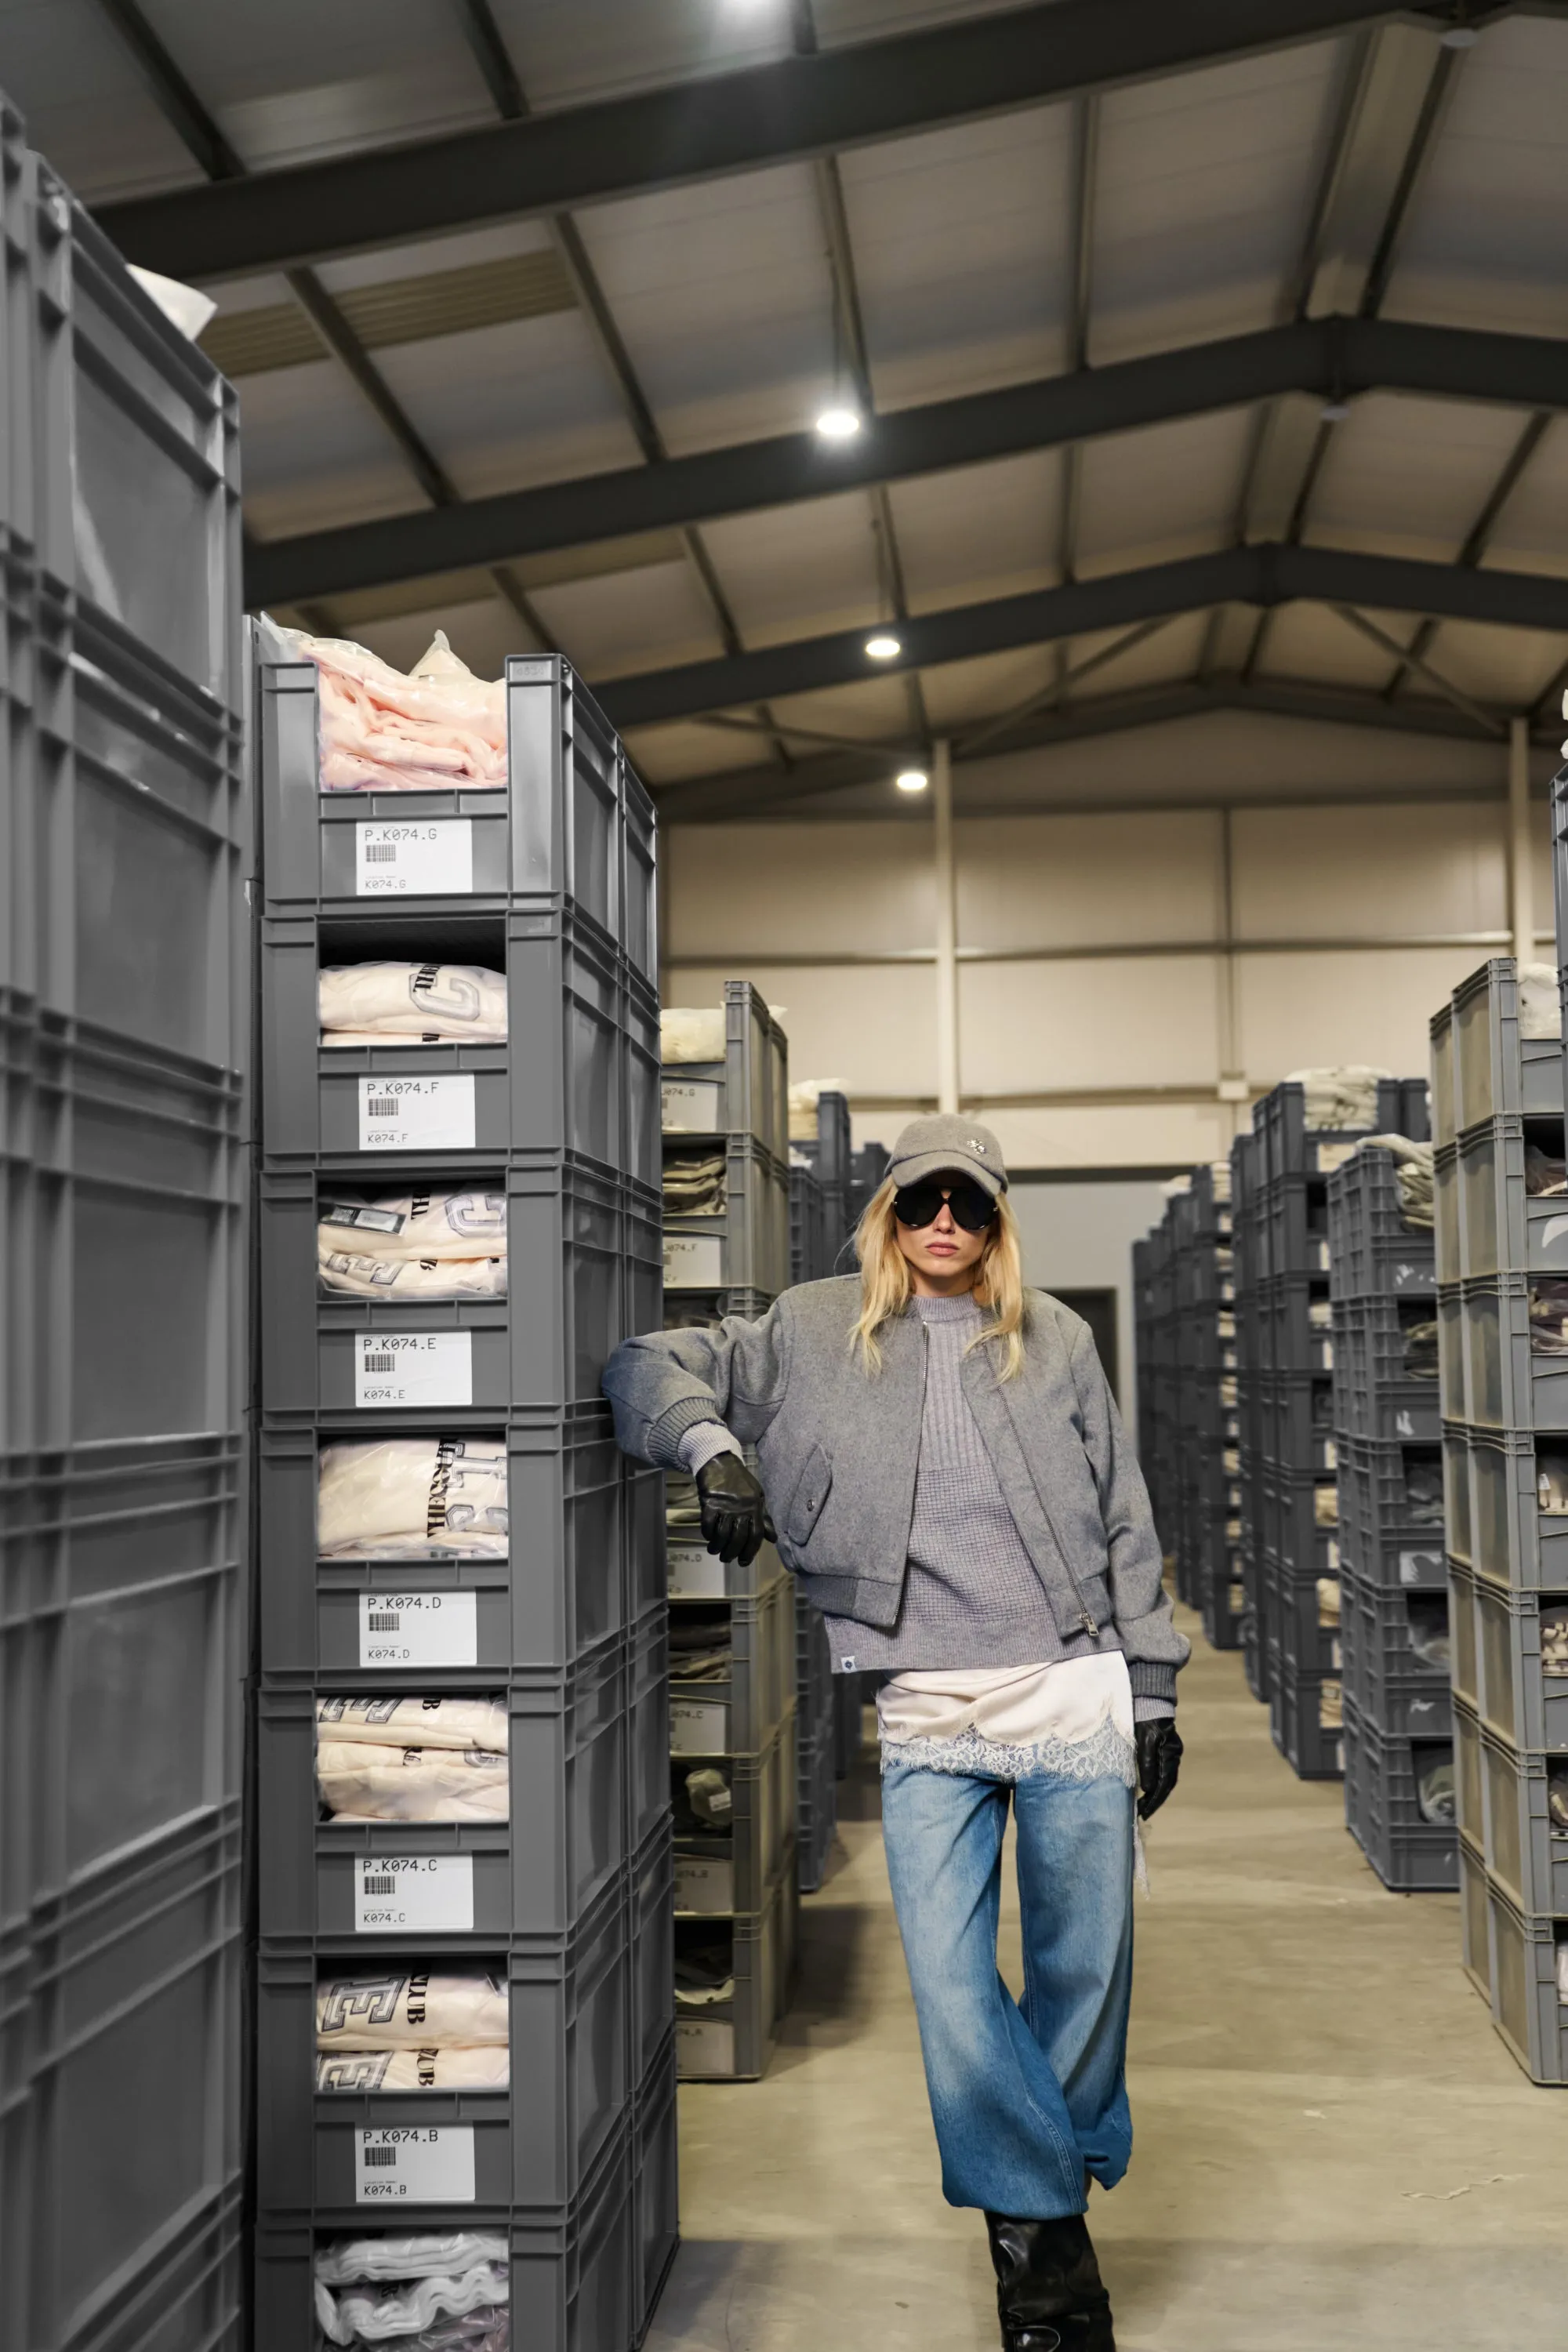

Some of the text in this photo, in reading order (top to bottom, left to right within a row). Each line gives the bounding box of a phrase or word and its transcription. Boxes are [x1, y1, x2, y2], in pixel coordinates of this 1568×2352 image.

[365, 827, 437, 841] P.K074.G
[365, 879, 406, 889] K074.G
[367, 1081, 439, 1095] P.K074.F
[367, 1133, 408, 1144] K074.F
[363, 1338, 437, 1351] P.K074.E
[364, 1389, 405, 1399] K074.E
[367, 1596, 441, 1610] P.K074.D
[368, 1649, 410, 1659] K074.D
[363, 1859, 437, 1873] P.K074.C
[364, 1913, 406, 1923] K074.C
[363, 2129, 439, 2143] P.K074.B
[364, 2184, 407, 2196] K074.B
